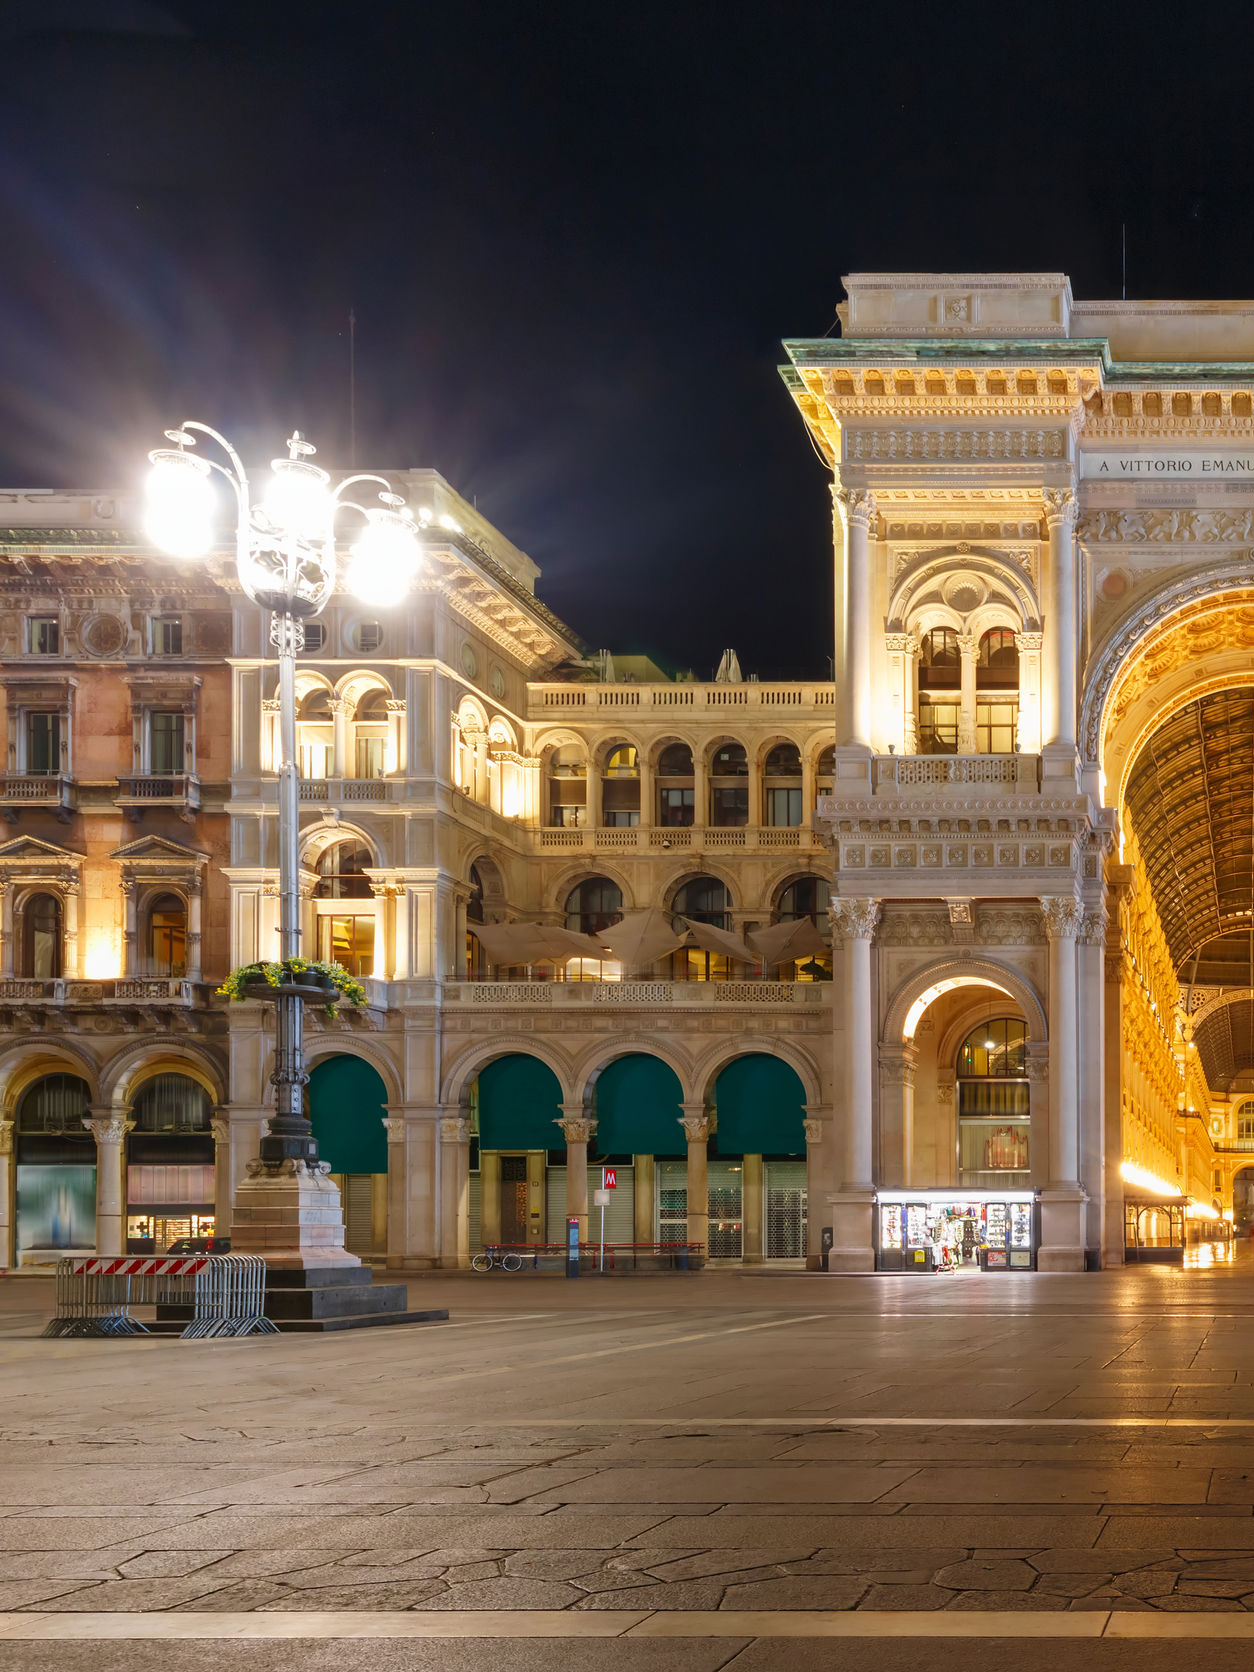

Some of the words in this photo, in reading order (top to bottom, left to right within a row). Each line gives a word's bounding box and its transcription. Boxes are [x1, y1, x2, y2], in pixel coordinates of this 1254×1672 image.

[1099, 460, 1109, 472] A
[1119, 460, 1193, 472] VITTORIO
[606, 1172, 616, 1185] M
